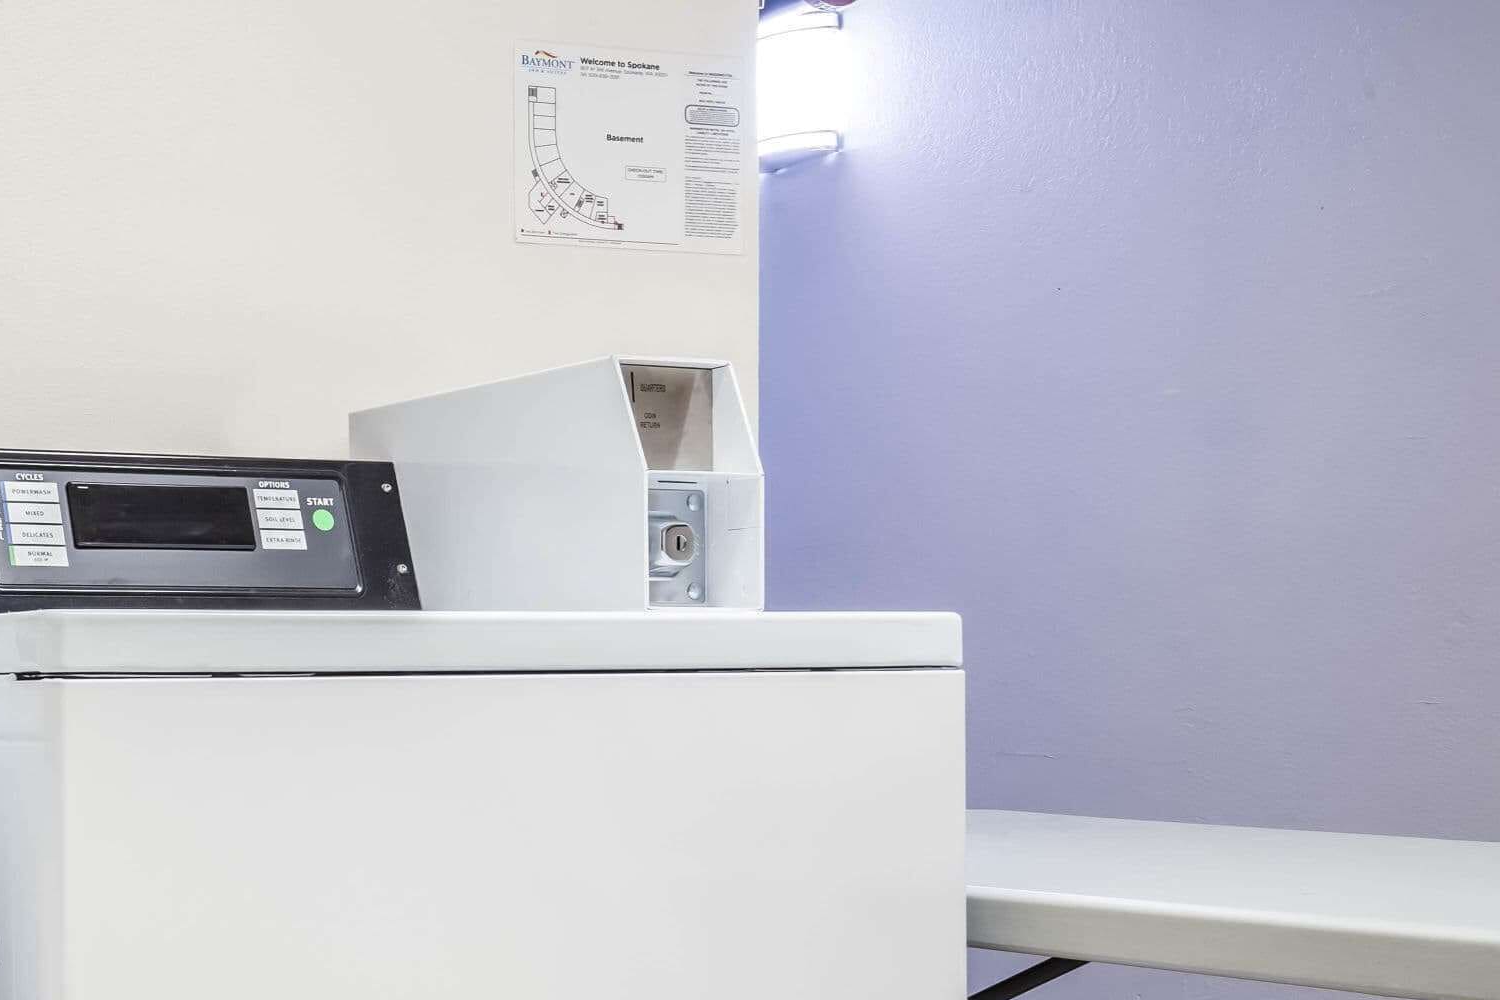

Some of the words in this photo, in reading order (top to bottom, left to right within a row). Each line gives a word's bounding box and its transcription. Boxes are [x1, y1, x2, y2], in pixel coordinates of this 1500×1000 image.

[521, 54, 577, 69] BAYMONT
[580, 57, 616, 67] Welcome
[627, 61, 660, 71] Spokane
[606, 133, 644, 143] Basement
[15, 472, 44, 480] CYCLES
[306, 497, 334, 506] START
